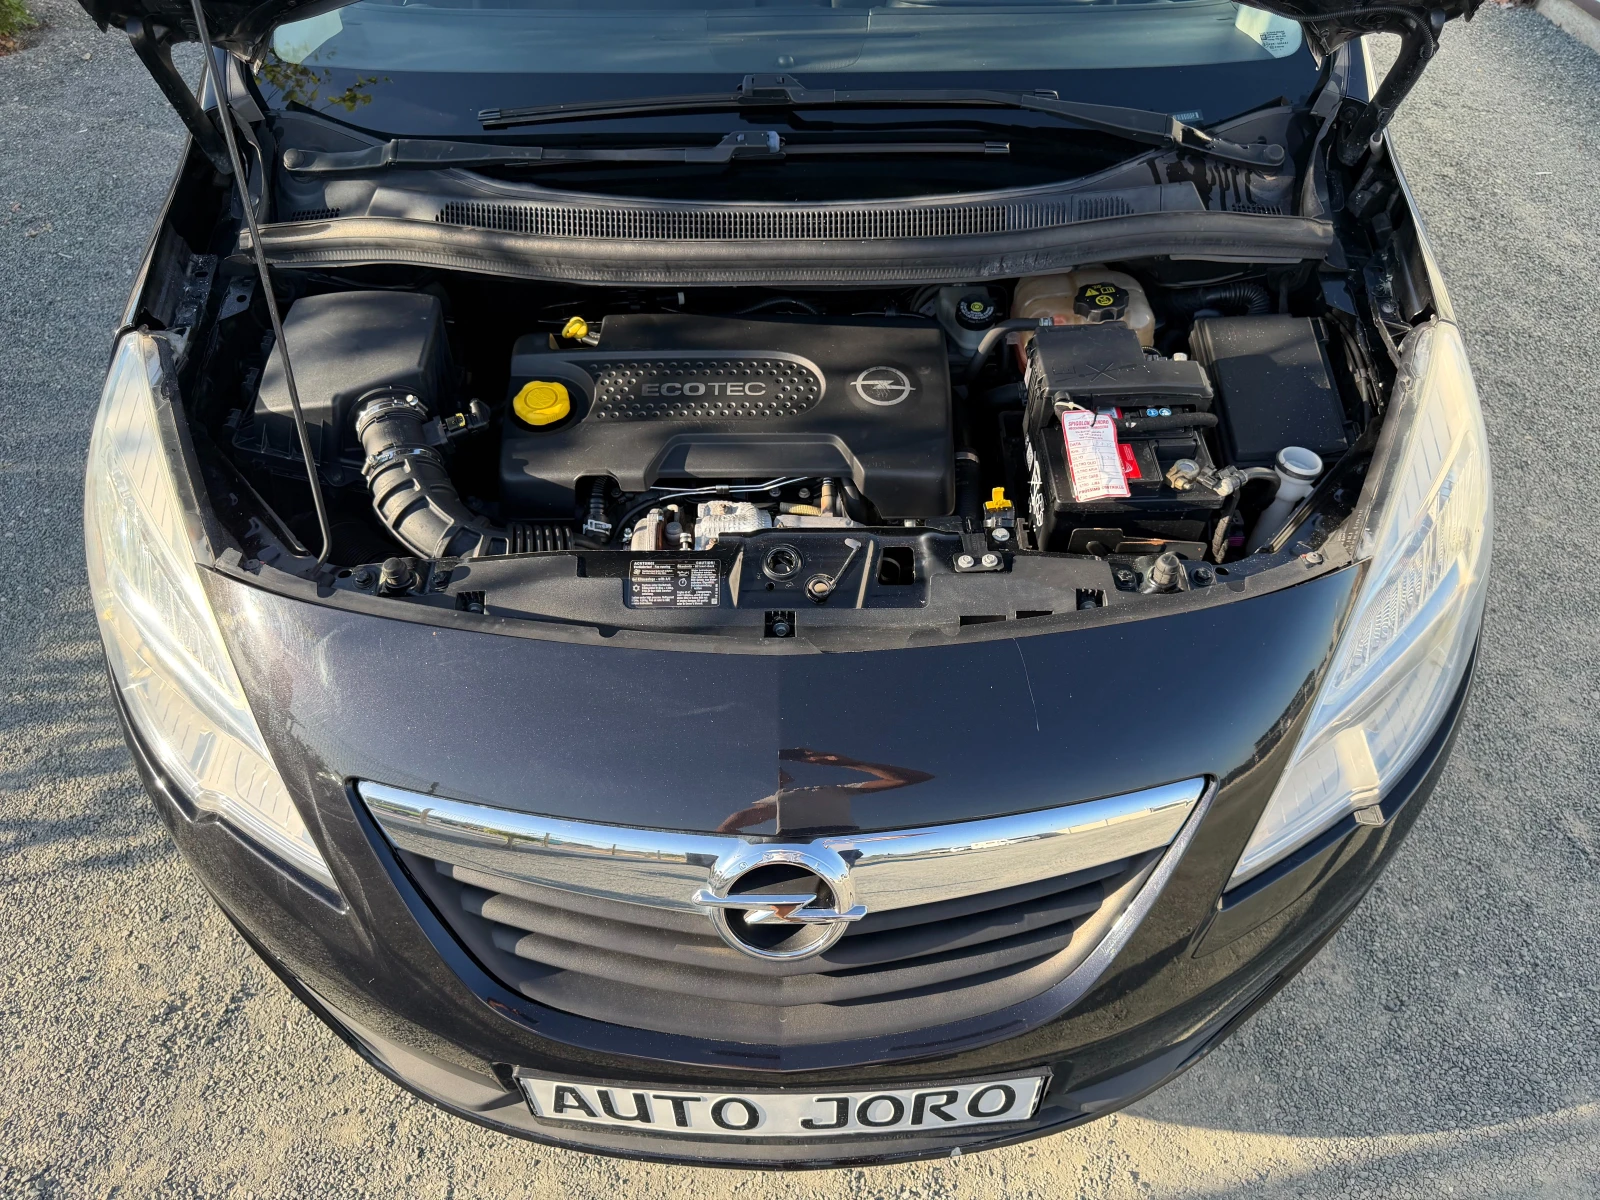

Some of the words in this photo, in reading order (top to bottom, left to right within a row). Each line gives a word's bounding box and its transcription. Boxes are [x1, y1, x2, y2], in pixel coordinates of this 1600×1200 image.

[641, 382, 766, 397] ECOTEC
[553, 1085, 760, 1131] AUTO
[800, 1084, 1017, 1130] JORO
